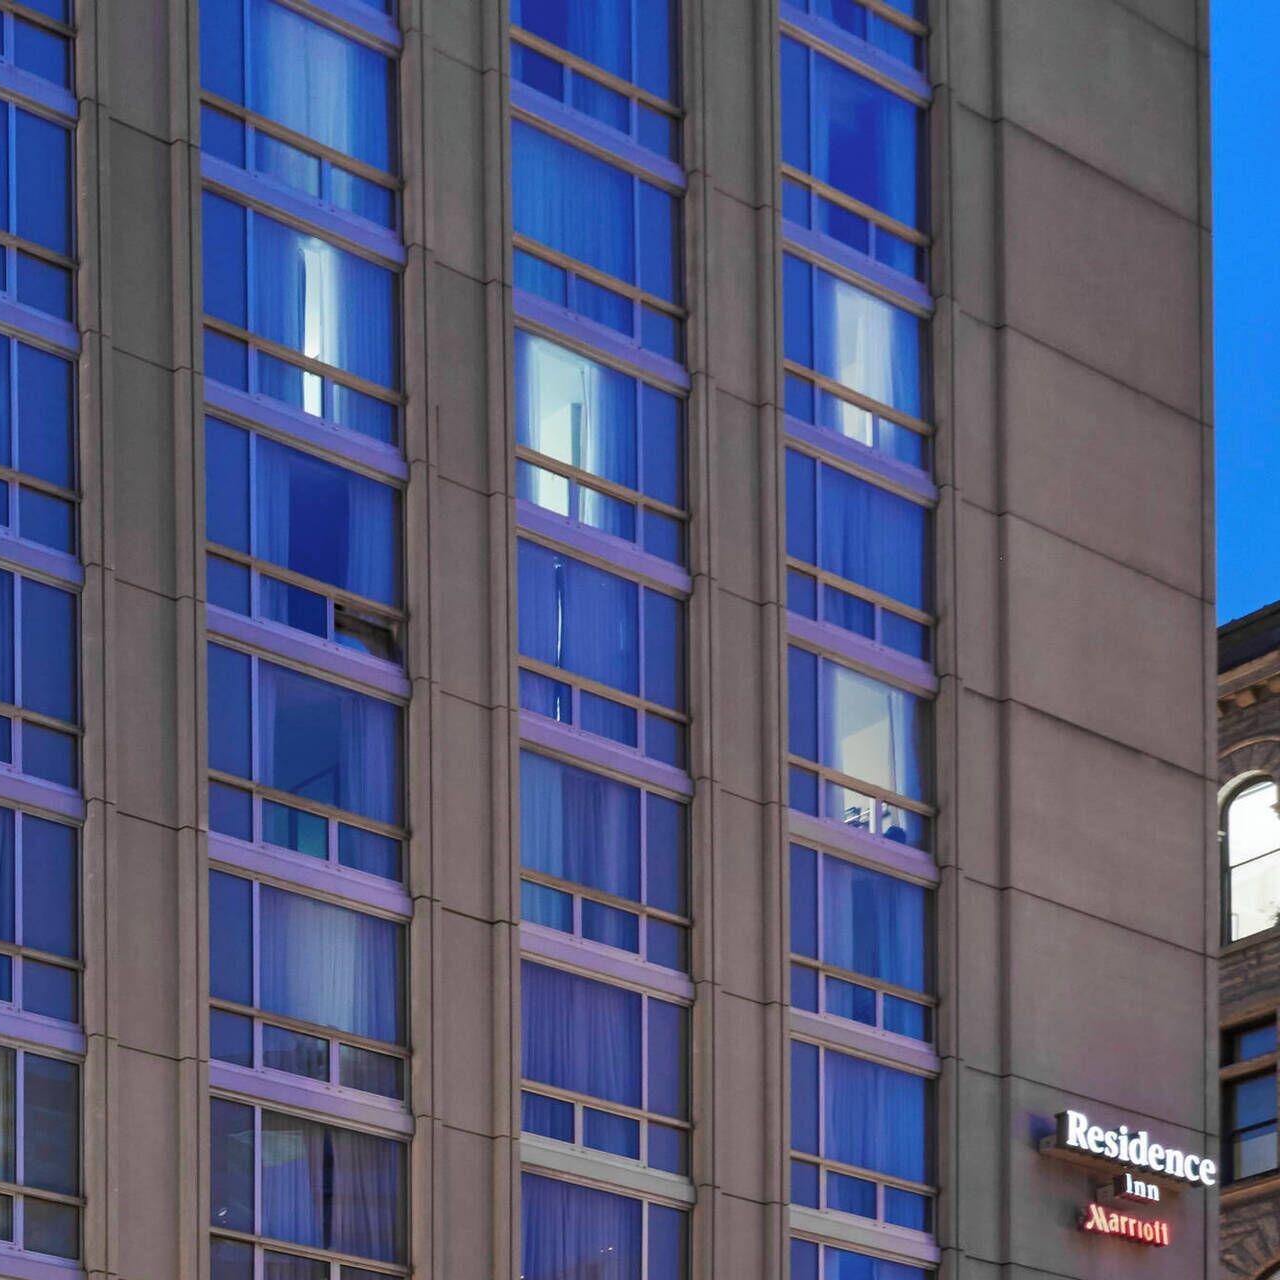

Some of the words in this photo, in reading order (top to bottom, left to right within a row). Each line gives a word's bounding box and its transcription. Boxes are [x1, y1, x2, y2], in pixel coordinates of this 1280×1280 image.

[1066, 1110, 1216, 1186] Residence
[1125, 1173, 1160, 1202] Inn
[1085, 1203, 1170, 1246] Marriott
